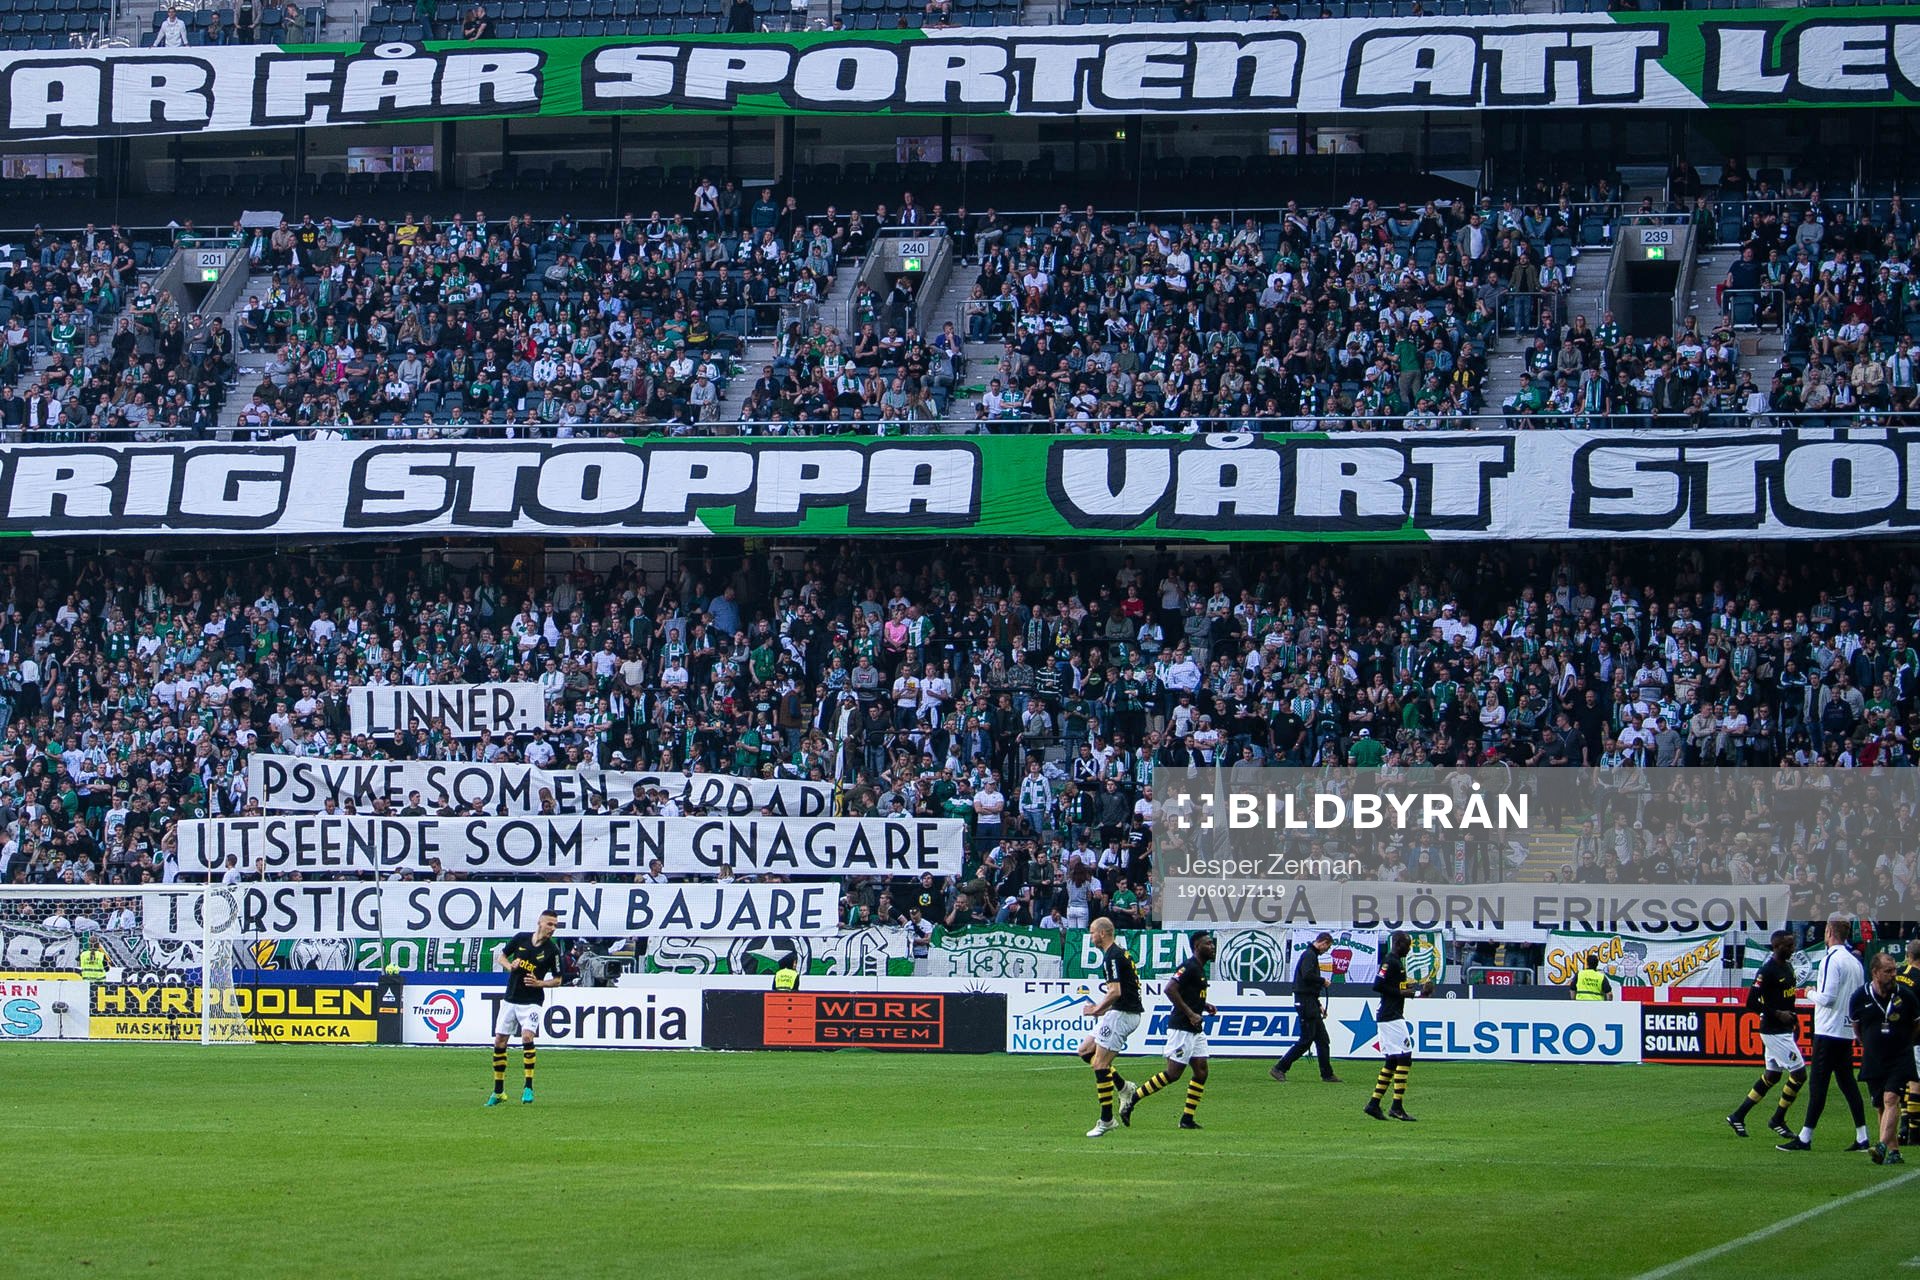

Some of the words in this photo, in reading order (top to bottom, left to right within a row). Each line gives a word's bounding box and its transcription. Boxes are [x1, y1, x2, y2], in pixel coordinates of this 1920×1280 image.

[265, 43, 541, 117] FÅR
[594, 40, 1299, 102] SPORTEN
[1356, 30, 1660, 96] ATT
[1716, 24, 1920, 93] LE
[1644, 231, 1669, 242] 239
[902, 243, 925, 254] 240
[202, 254, 222, 265] 201
[0, 452, 286, 518] RIG
[361, 448, 975, 515] STOPPA
[1061, 431, 1504, 516] VÅRT
[1589, 428, 1920, 515] STÖ
[263, 760, 403, 806] PSYKE
[427, 765, 532, 811] SOM
[197, 819, 440, 868] UTSEENDE
[465, 819, 583, 867] SOM
[609, 820, 665, 867] EN
[692, 820, 939, 869] GNAGARE
[407, 887, 523, 931] SOM
[626, 887, 825, 931] BAJARE
[1187, 884, 1317, 925] AVGÅ
[1352, 888, 1505, 930] BJÖRN
[1533, 895, 1768, 933] ERIKSSON
[941, 930, 1051, 951] SEKTION
[949, 948, 1037, 978] 138
[1643, 936, 1721, 987] BAJARE
[1489, 975, 1510, 986] 139
[413, 1006, 452, 1016] Thermia
[481, 992, 687, 1041] Termia
[822, 1001, 932, 1019] WORK
[291, 1024, 351, 1039] NACKA
[1012, 1015, 1098, 1034] Takprodu
[1147, 1014, 1301, 1037] KTEPA
[1645, 1012, 1698, 1031] EKERÖ
[823, 1027, 930, 1039] SYSTEM
[1645, 1035, 1700, 1052] SOLNA
